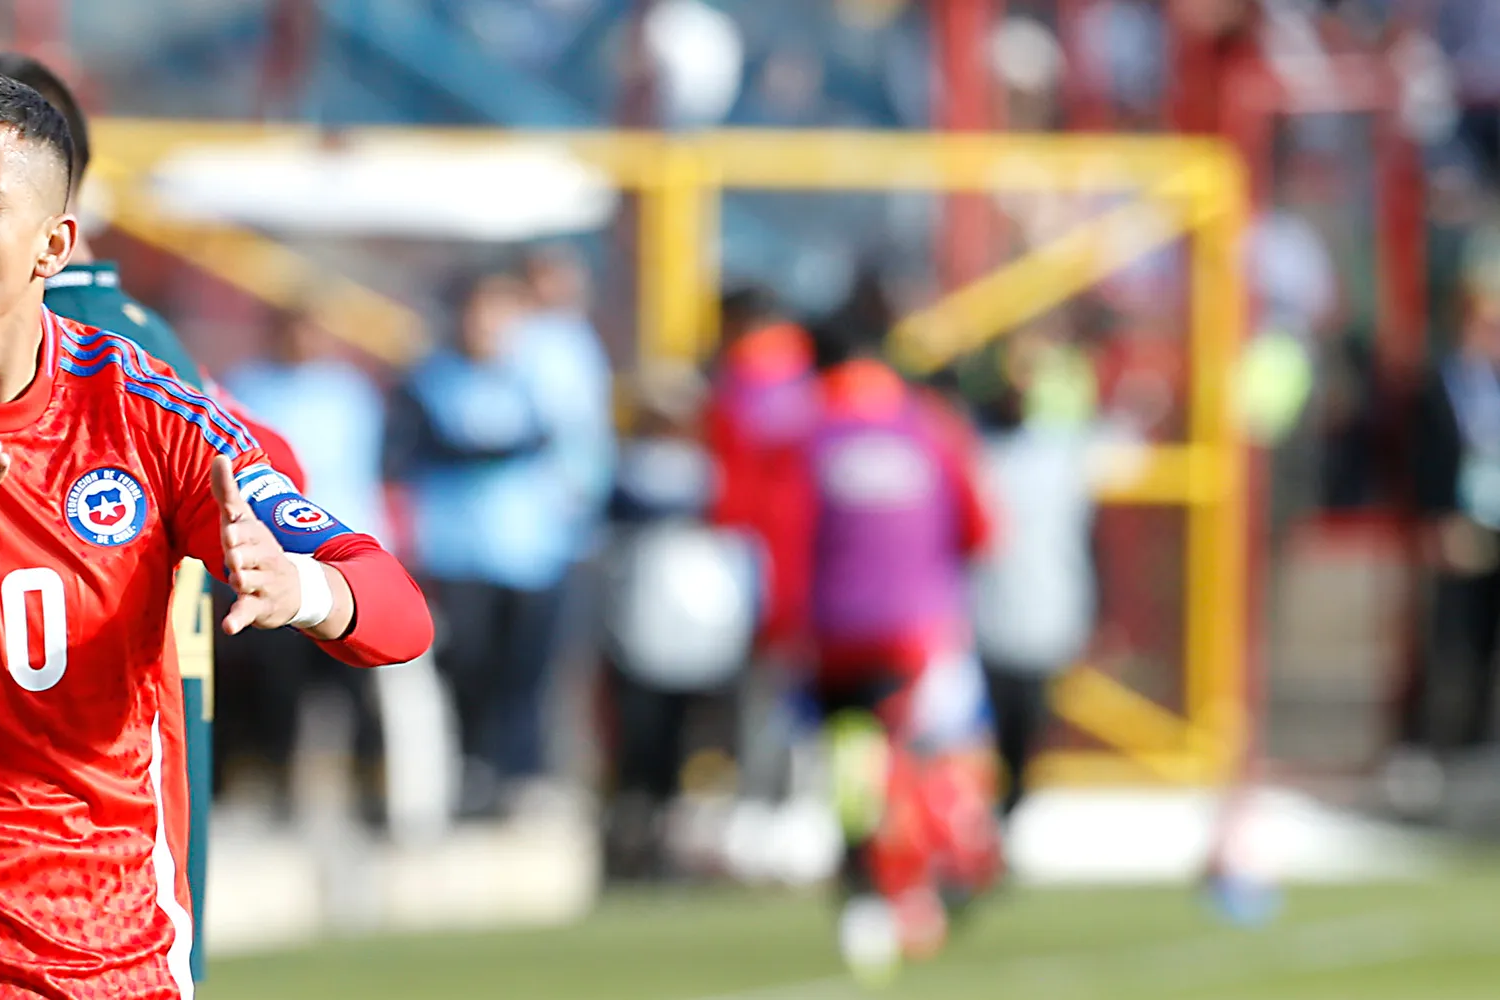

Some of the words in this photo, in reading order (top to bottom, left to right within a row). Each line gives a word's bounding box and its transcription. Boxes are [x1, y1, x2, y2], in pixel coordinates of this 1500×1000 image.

[67, 472, 99, 518] FEDERACION
[103, 470, 115, 480] DE
[117, 473, 143, 502] FUTBOL
[97, 534, 109, 545] DE
